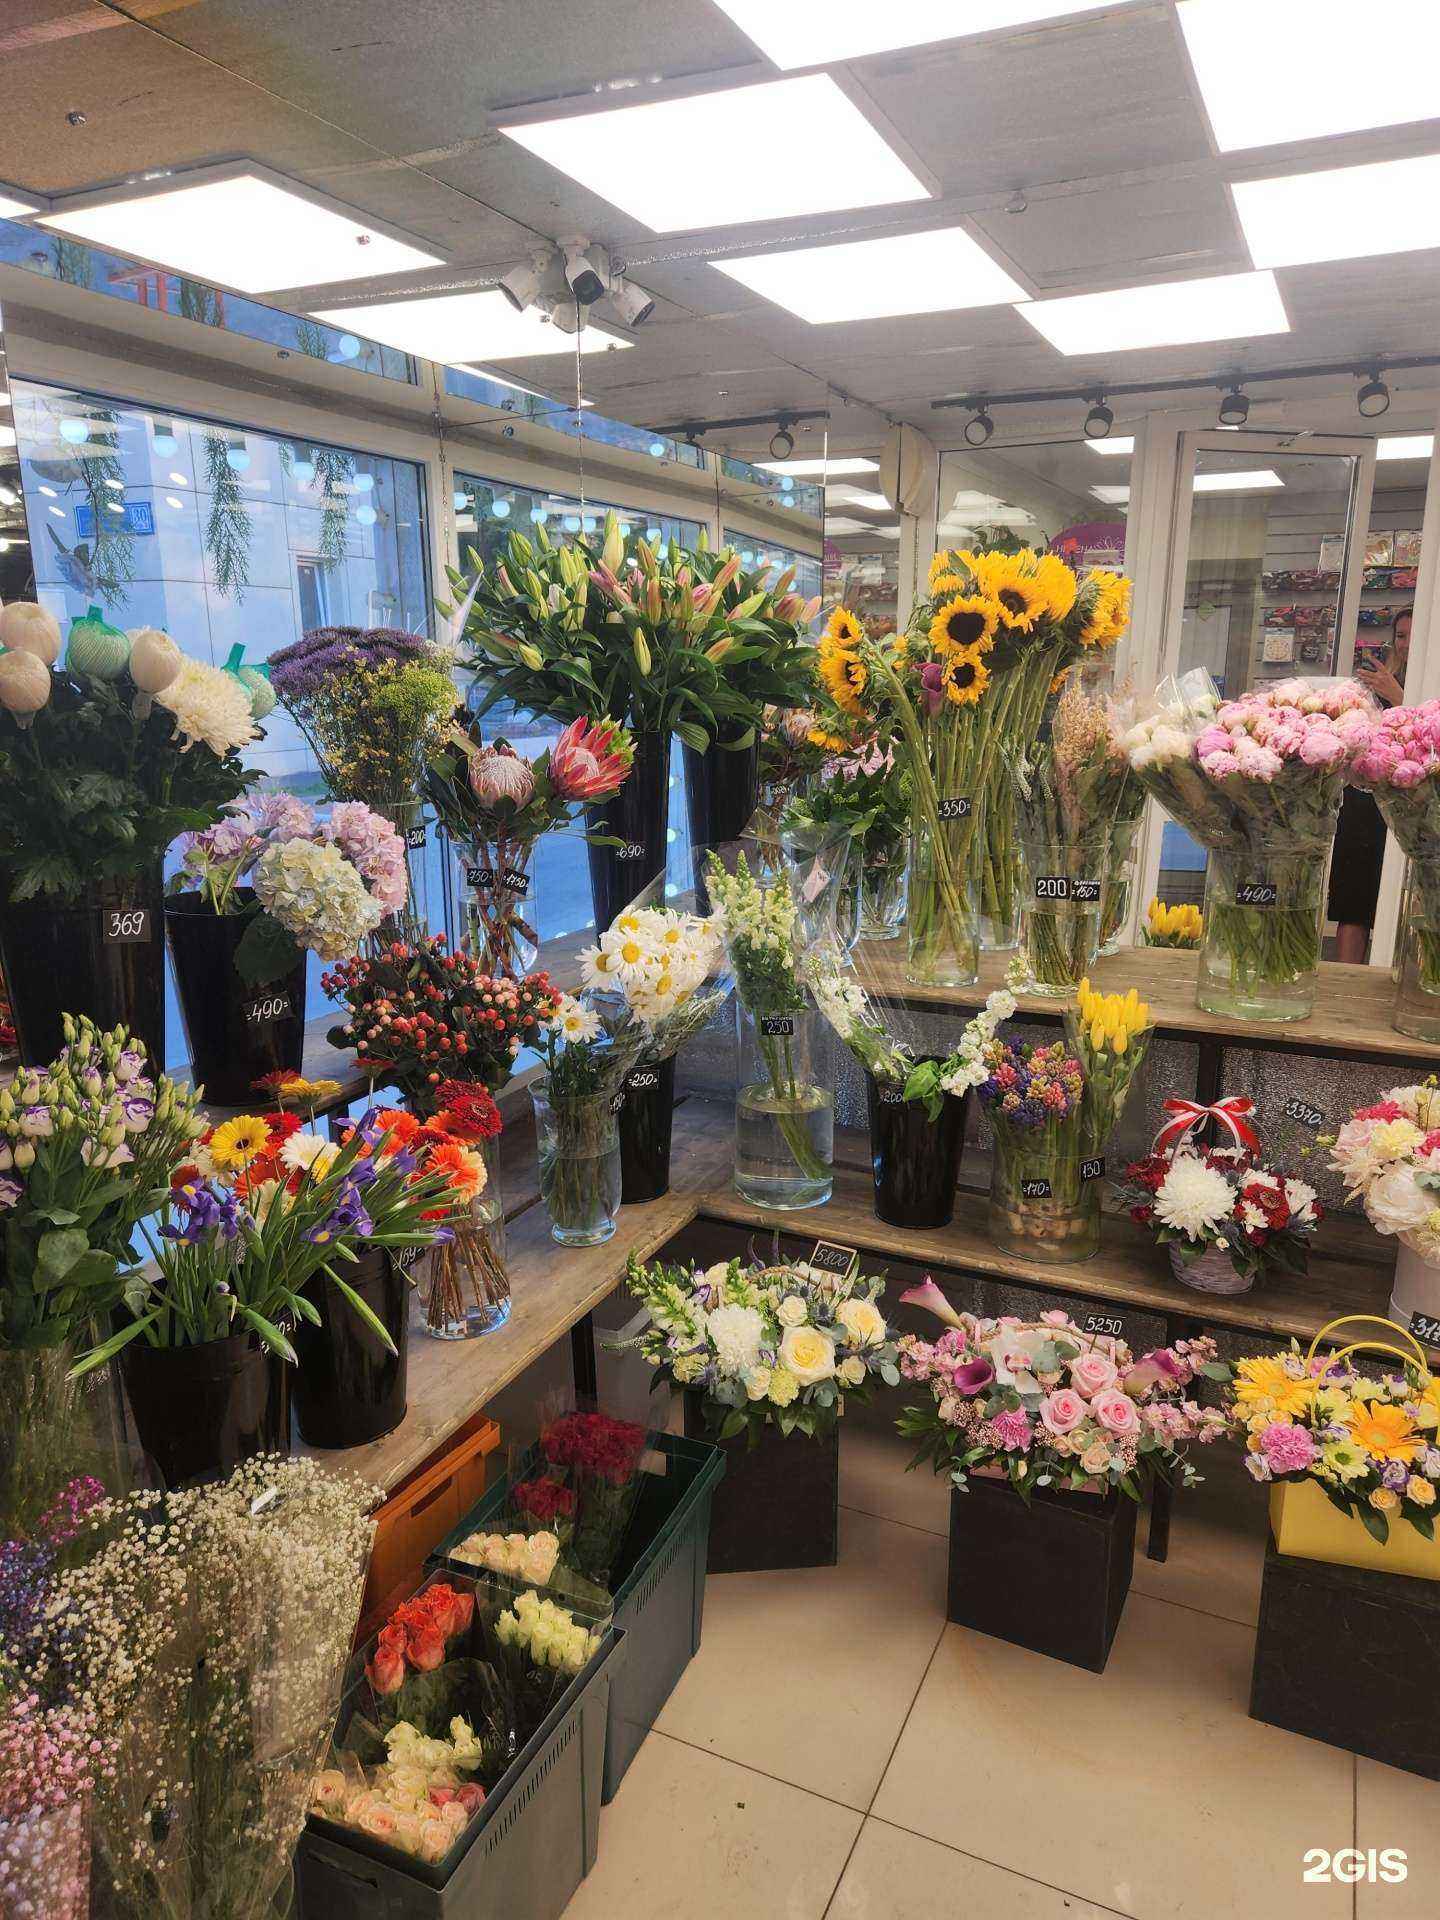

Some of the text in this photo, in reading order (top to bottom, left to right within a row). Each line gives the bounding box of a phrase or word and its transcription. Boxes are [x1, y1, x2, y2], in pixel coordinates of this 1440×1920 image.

[1037, 879, 1067, 896] 200
[108, 911, 145, 937] 369
[814, 1247, 849, 1266] 5800
[1086, 1317, 1122, 1335] 5250
